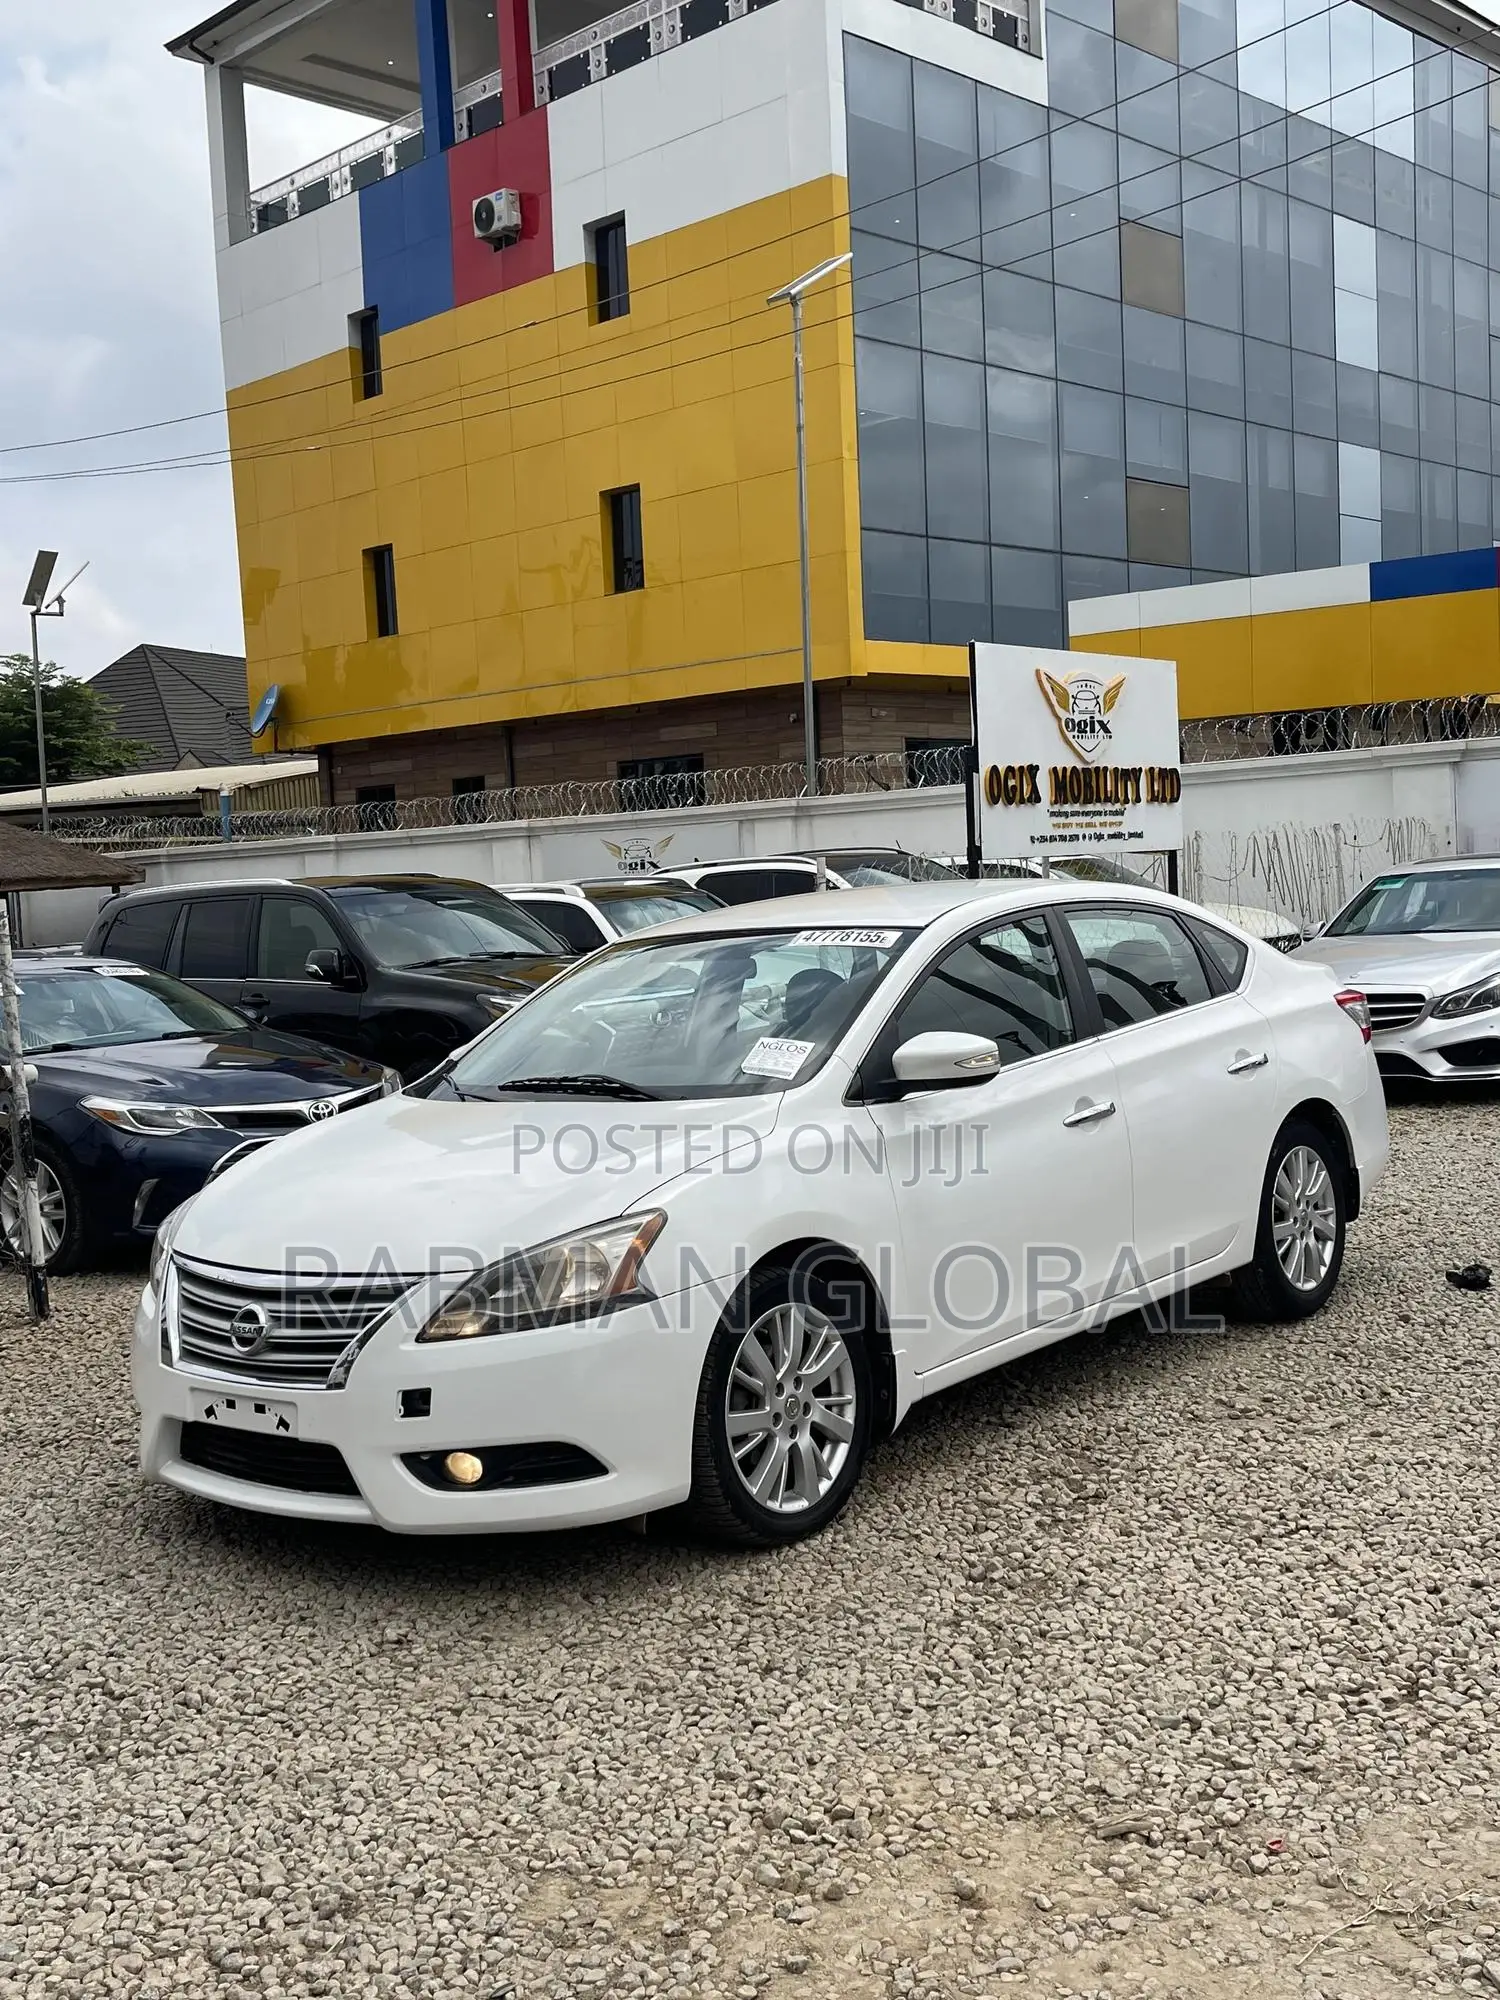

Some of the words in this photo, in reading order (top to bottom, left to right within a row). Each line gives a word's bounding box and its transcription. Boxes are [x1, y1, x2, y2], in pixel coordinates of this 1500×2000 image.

[984, 764, 1042, 805] OGIX
[1049, 765, 1143, 805] MOBILITY
[1144, 766, 1182, 805] LTD
[758, 1041, 808, 1059] NGLOS
